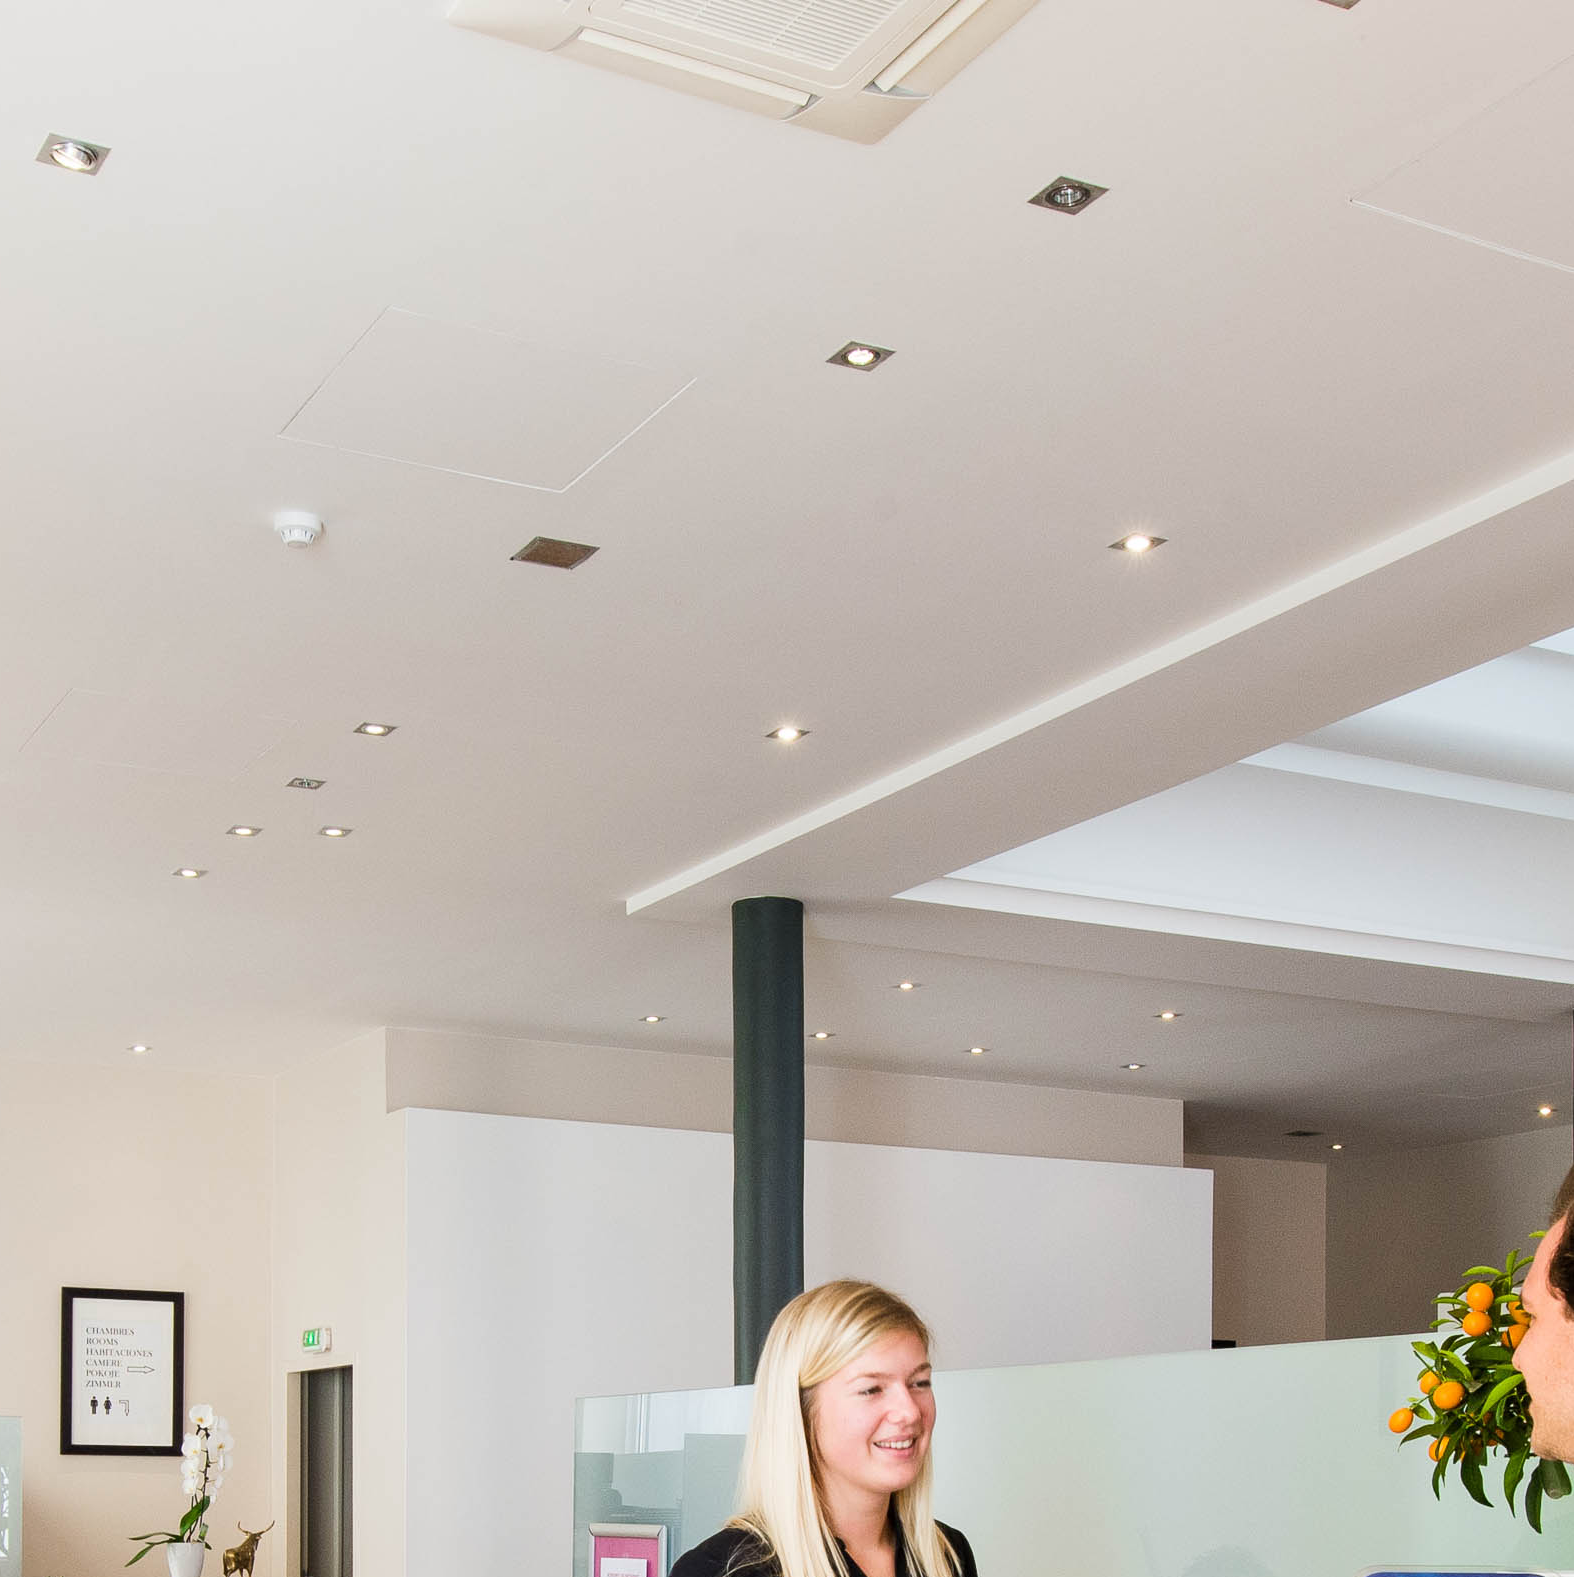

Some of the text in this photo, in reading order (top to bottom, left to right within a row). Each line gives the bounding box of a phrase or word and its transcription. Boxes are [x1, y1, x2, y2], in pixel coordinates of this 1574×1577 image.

[85, 1327, 135, 1336] CHAMBRES
[85, 1337, 119, 1345] ROOMS
[85, 1347, 153, 1357] HABITACIONES
[85, 1359, 122, 1367] CAMERE
[85, 1379, 121, 1388] ZIMMER
